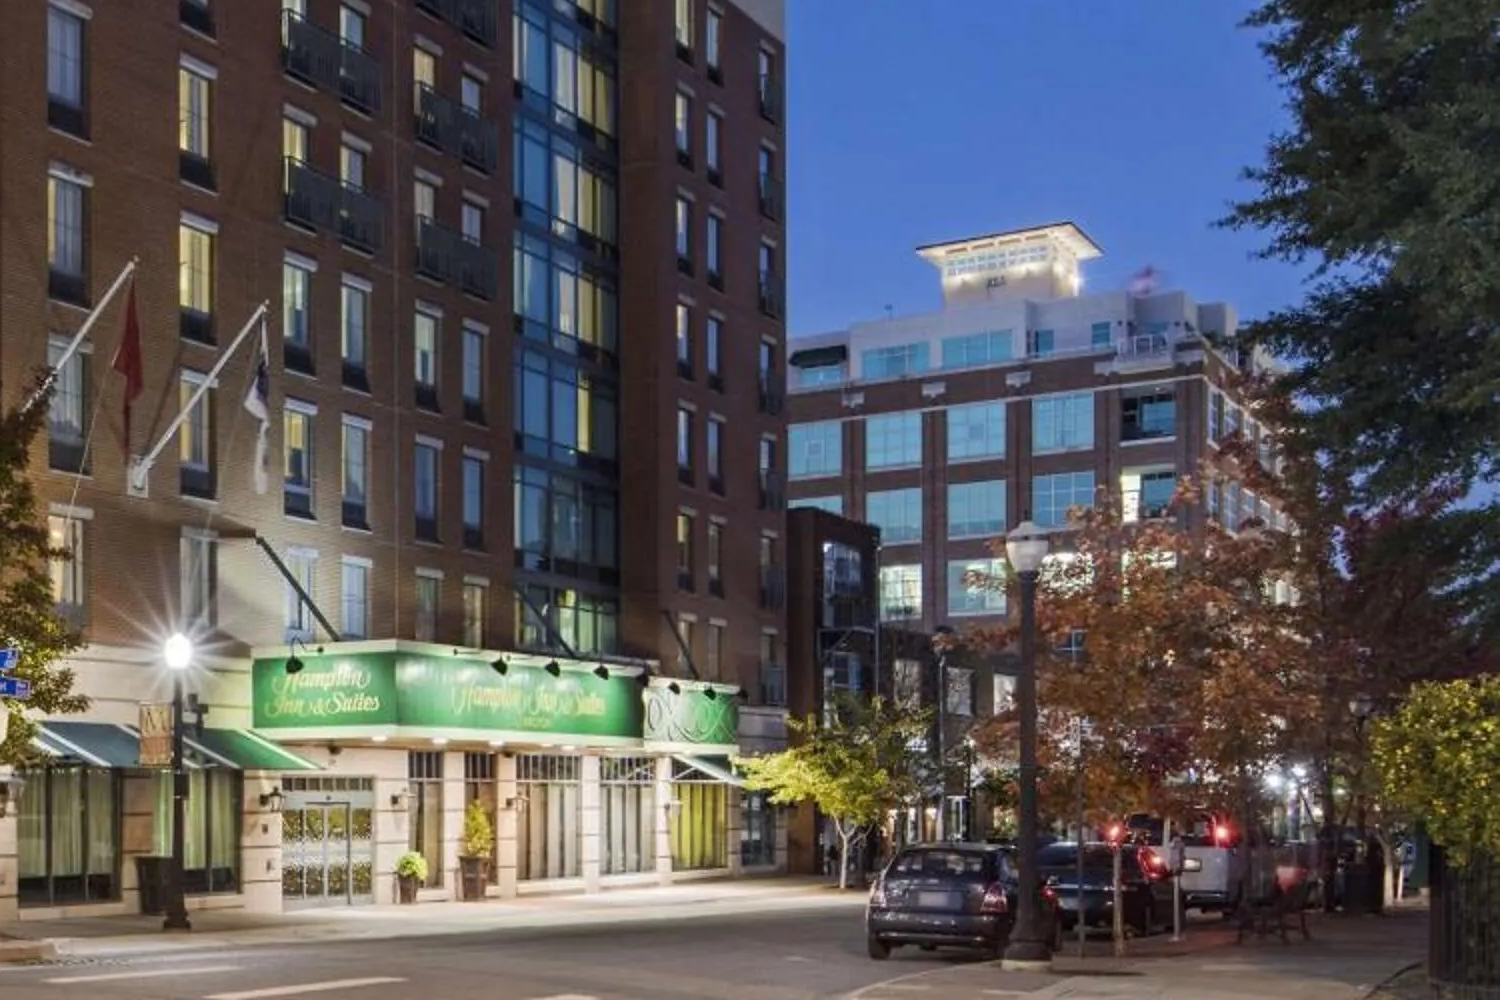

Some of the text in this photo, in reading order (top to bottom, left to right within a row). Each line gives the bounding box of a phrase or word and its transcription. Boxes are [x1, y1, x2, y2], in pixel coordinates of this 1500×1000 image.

[272, 663, 371, 695] Hampton
[265, 692, 380, 718] Inn & Suites
[451, 682, 526, 716] Hampton
